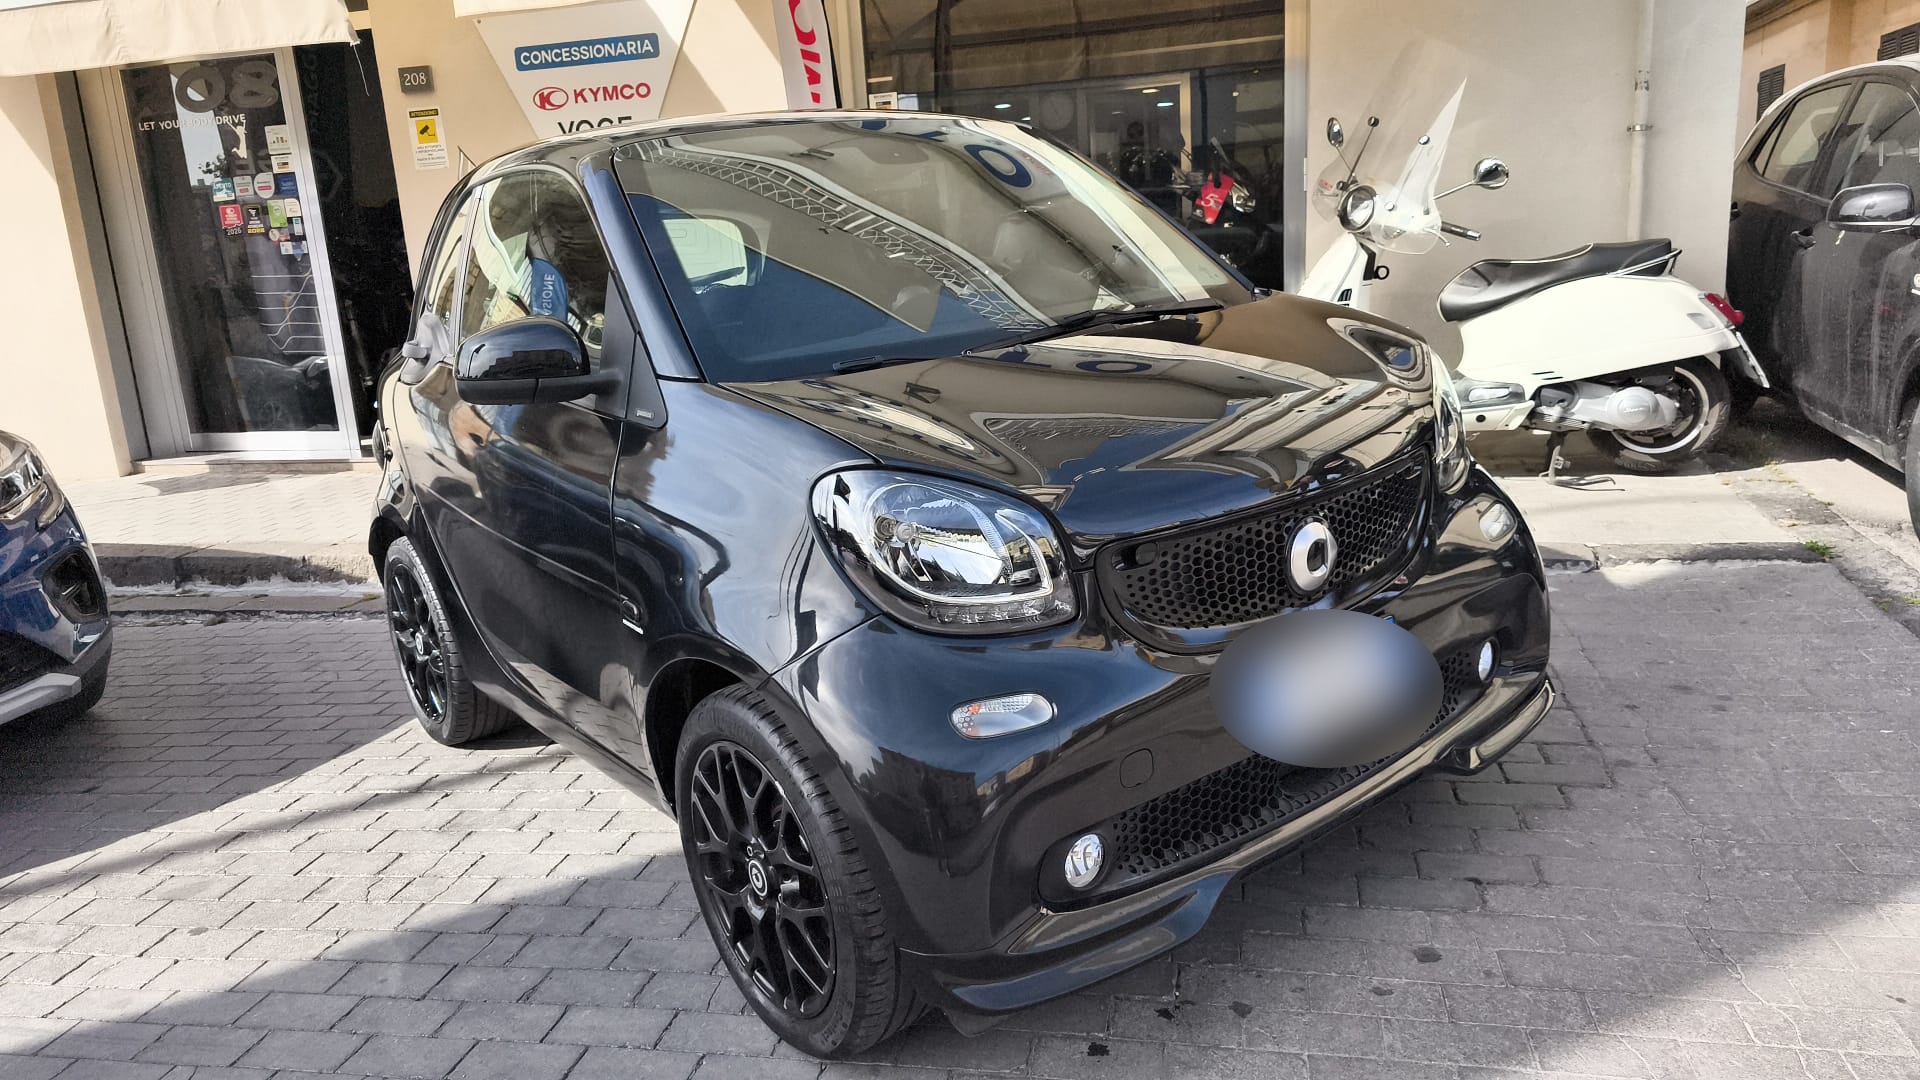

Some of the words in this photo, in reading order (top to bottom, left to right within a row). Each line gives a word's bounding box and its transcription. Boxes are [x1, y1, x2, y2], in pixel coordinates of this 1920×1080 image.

[520, 39, 654, 66] CONCESSIONARIA
[403, 72, 427, 86] 208
[573, 82, 652, 104] KYMCO
[138, 121, 156, 131] LET
[158, 119, 186, 130] YOU
[215, 113, 247, 125] DRIVE
